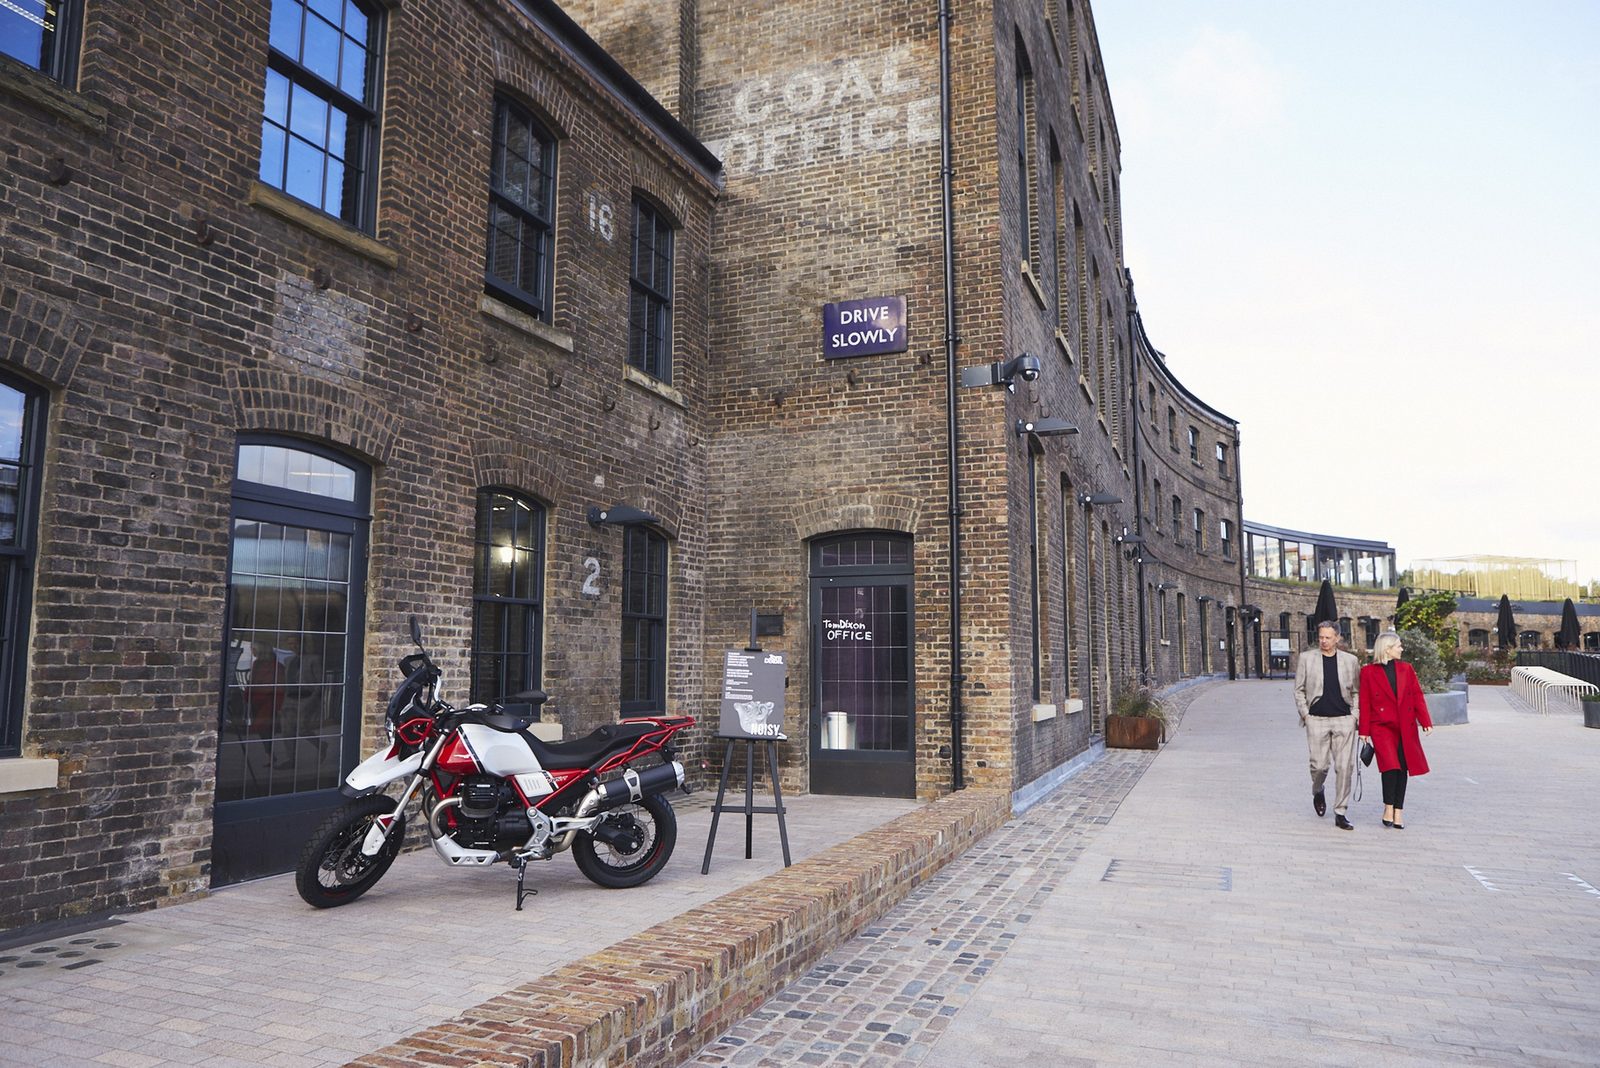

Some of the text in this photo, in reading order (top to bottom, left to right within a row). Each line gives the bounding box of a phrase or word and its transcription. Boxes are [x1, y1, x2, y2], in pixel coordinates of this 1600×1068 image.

[735, 50, 921, 124] COAL
[720, 97, 941, 172] OFFICE
[840, 306, 889, 325] DRIVE
[832, 327, 898, 348] SLOWLY
[582, 556, 601, 596] 2
[827, 630, 873, 641] OFFICE
[750, 723, 780, 736] NOISY
